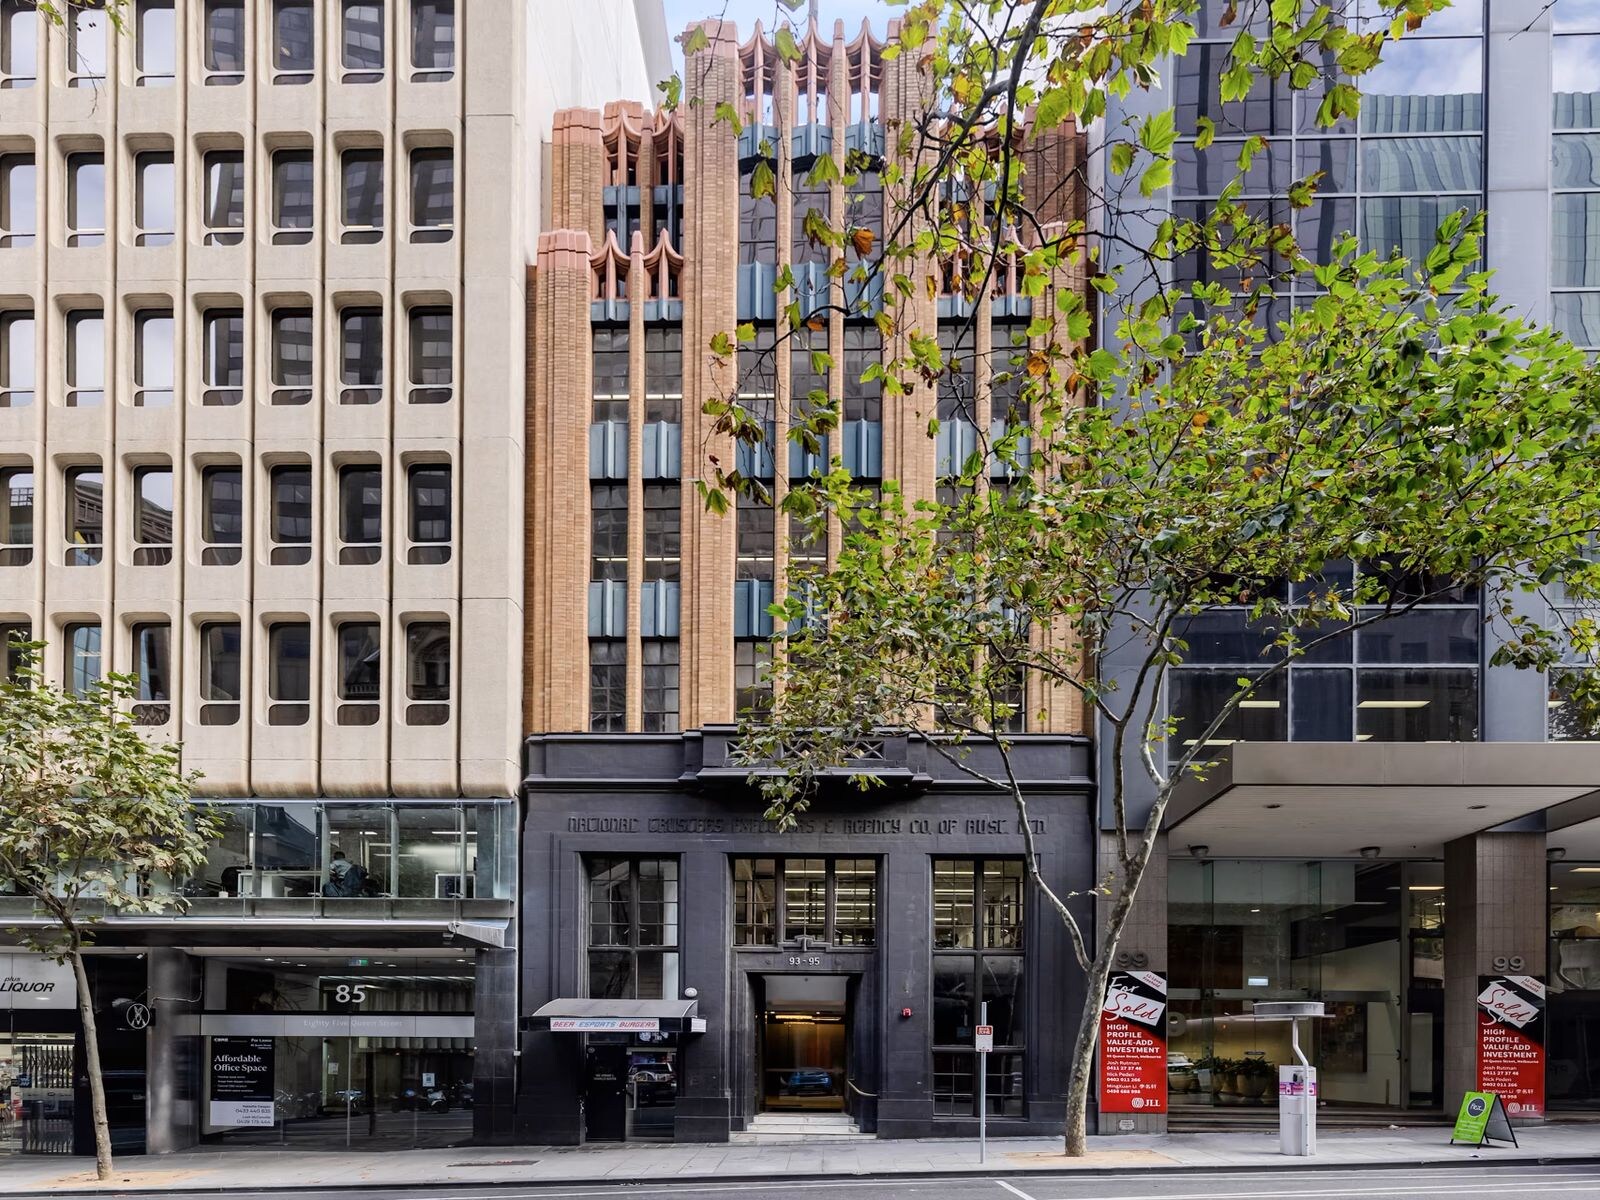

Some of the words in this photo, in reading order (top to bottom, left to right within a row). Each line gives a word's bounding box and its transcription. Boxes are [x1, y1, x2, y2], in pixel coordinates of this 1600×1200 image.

[938, 819, 958, 834] OF
[1492, 955, 1525, 972] 99
[0, 982, 55, 992] LIQUOR
[335, 984, 366, 1003] 85
[1105, 993, 1159, 1020] Sold
[1478, 988, 1531, 1022] Sold
[303, 1019, 330, 1028] Eighty
[214, 1054, 262, 1062] Affordable
[214, 1063, 240, 1072] Office
[241, 1064, 268, 1073] Space
[1144, 1099, 1160, 1107] JLL
[1521, 1104, 1537, 1112] JLL
